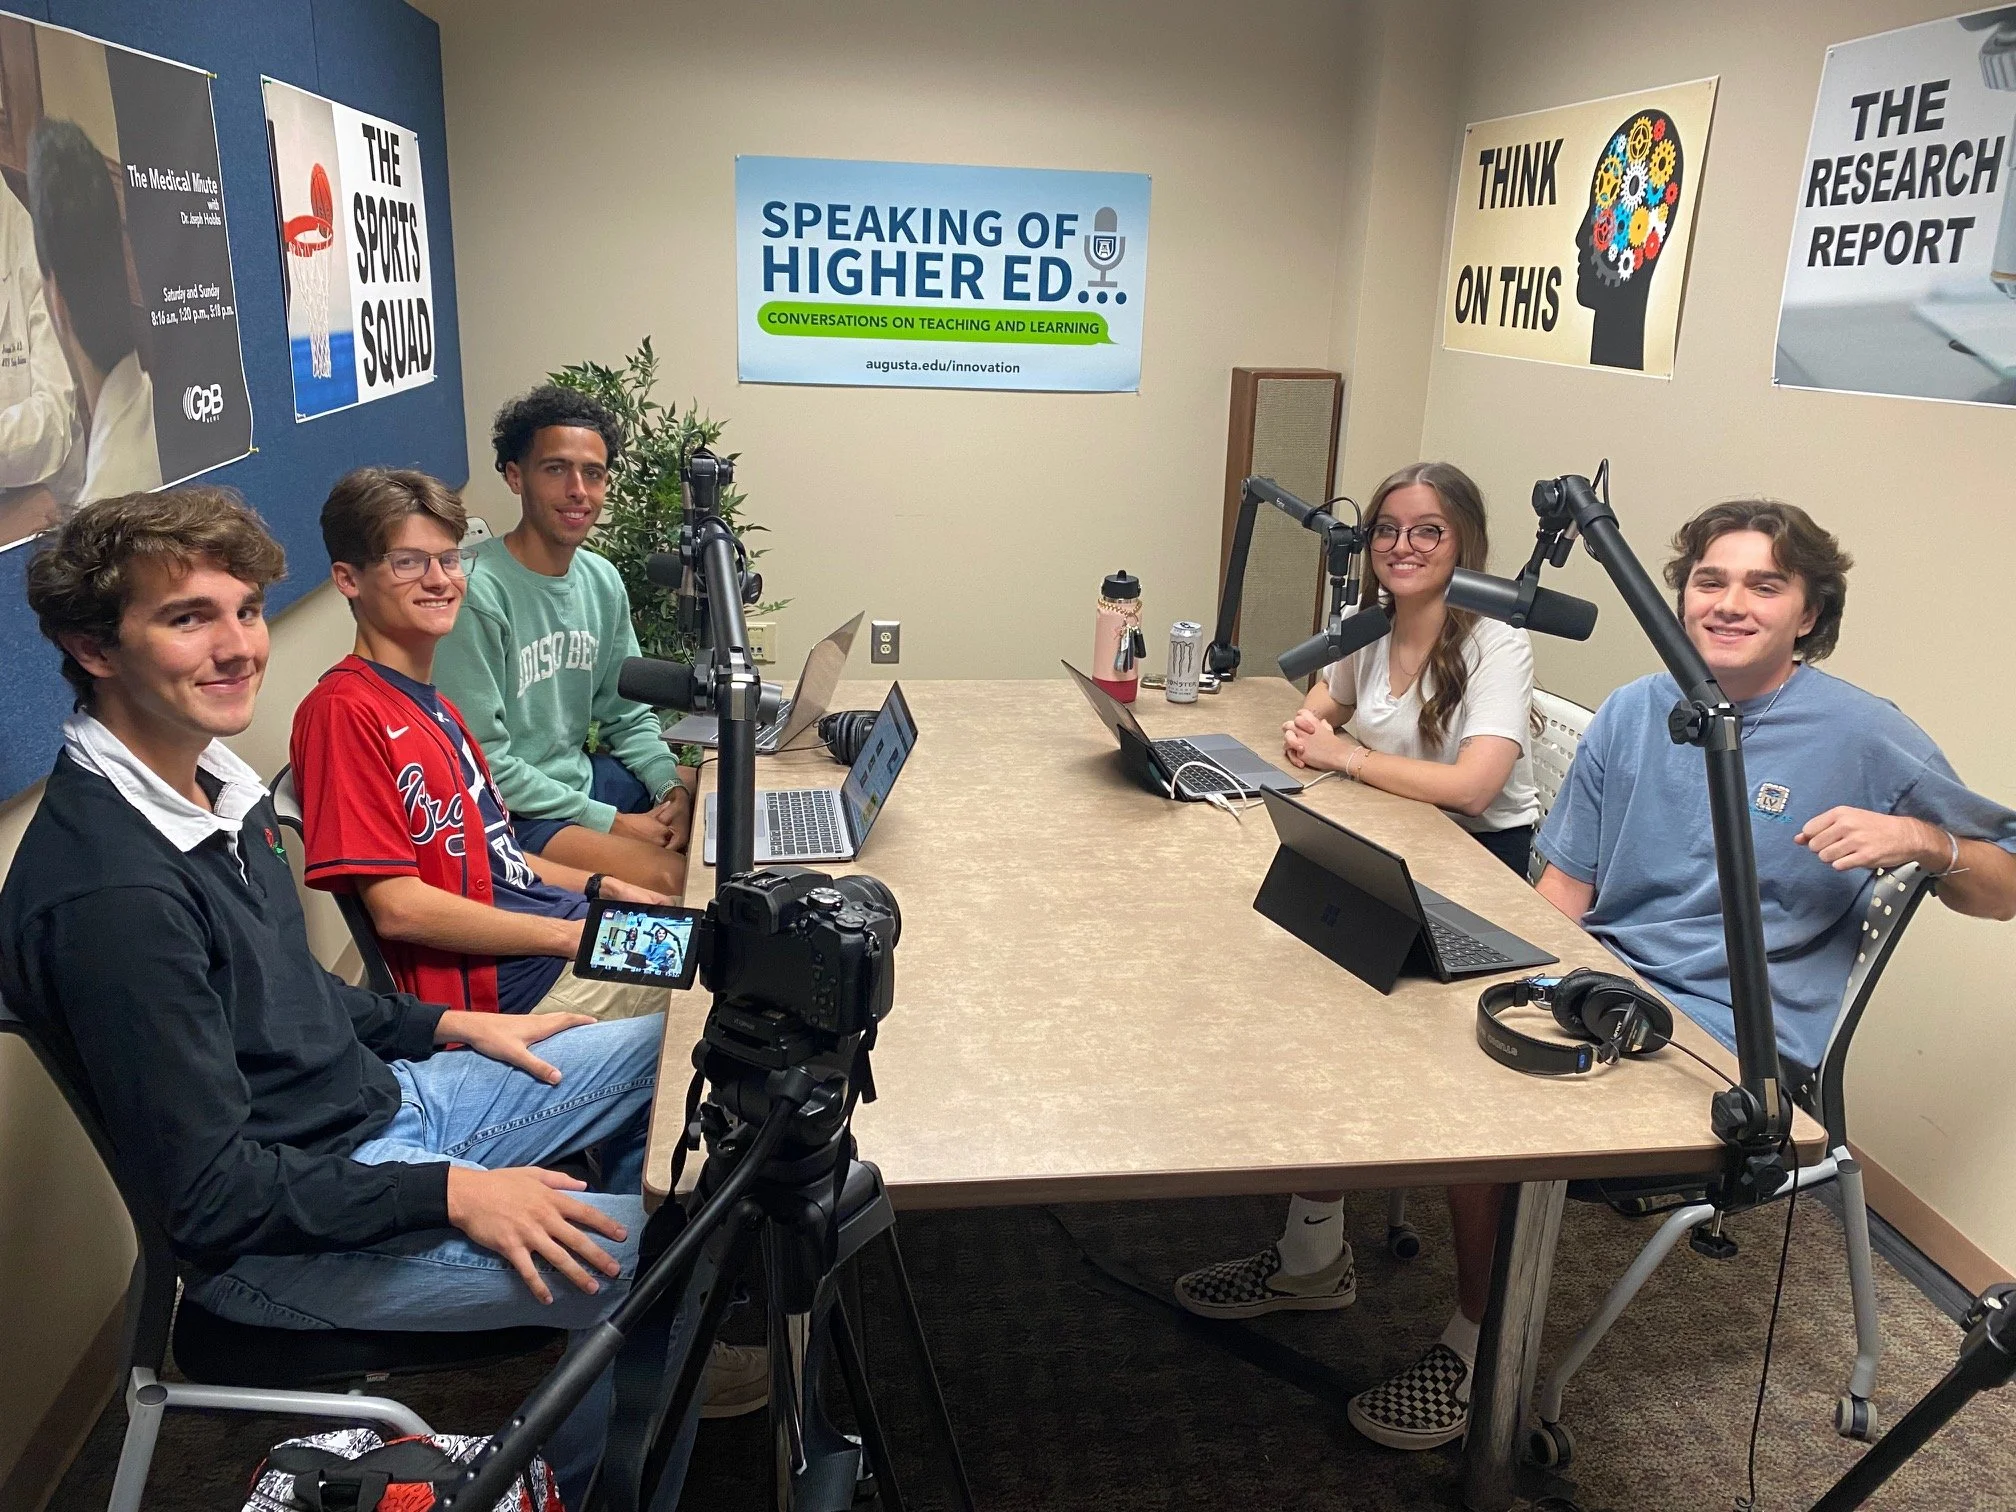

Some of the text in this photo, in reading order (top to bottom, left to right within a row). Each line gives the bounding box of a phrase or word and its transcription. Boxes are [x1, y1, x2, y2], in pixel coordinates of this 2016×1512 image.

[1851, 79, 1950, 141] THE
[127, 164, 148, 189] The
[148, 167, 192, 192] Medical
[361, 122, 402, 188] THE
[1478, 138, 1565, 210] THINK
[1805, 136, 2005, 209] RESEARCH
[206, 198, 220, 211] with
[761, 200, 1079, 250] SPEAKING OF
[353, 191, 421, 285] SPORTS
[1807, 216, 1976, 267] REPORT
[163, 283, 220, 304] Saturday and Sunday
[762, 245, 1127, 305] HIGHER ED...
[1455, 264, 1561, 333] ON THIS
[179, 306, 192, 322] 1:20
[767, 311, 1100, 335] CONVERSATIONS ON TEACHING AND LEARNING
[361, 297, 432, 388] SQUAD
[865, 358, 1020, 375] augusta.edu/innovation
